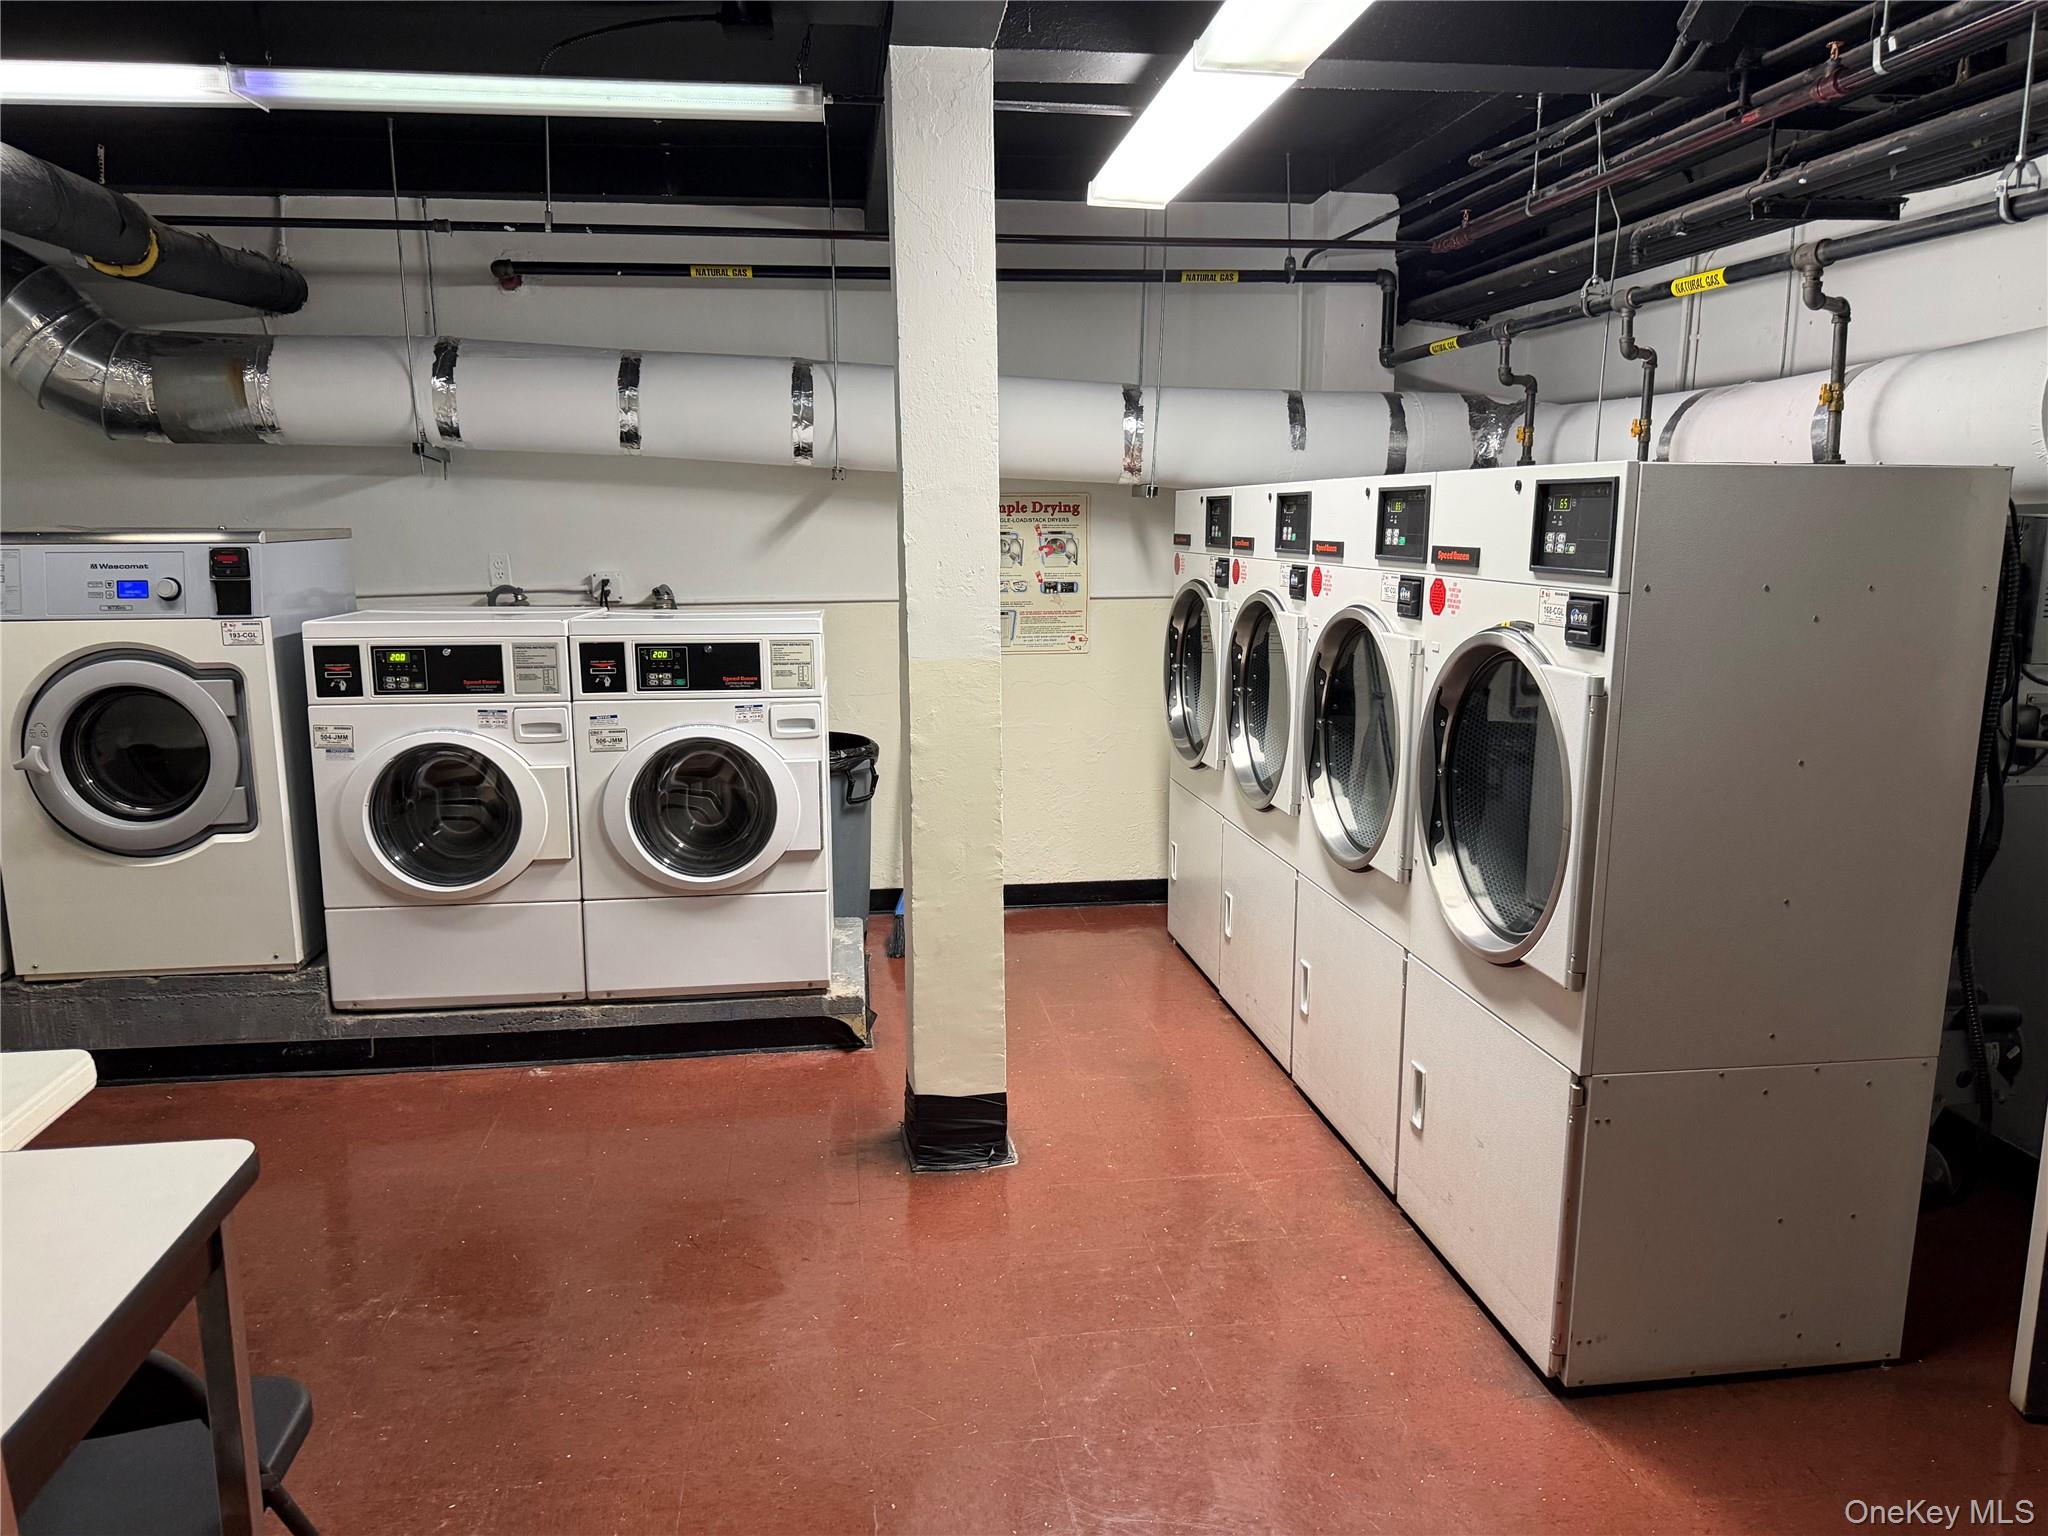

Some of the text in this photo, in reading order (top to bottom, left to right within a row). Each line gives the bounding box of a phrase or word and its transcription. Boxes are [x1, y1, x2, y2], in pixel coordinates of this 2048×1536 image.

[695, 268, 748, 277] NATURAL GAS
[1186, 273, 1234, 282] NATURAL GAS
[1675, 273, 1720, 294] NATURAL GAS
[1559, 498, 1568, 509] 65
[1031, 500, 1081, 517] Drying
[1437, 550, 1470, 561] Speed Queen
[389, 653, 406, 662] 200
[652, 650, 668, 659] 200
[320, 733, 349, 741] 504-JMM
[595, 736, 624, 744] 506-JMM
